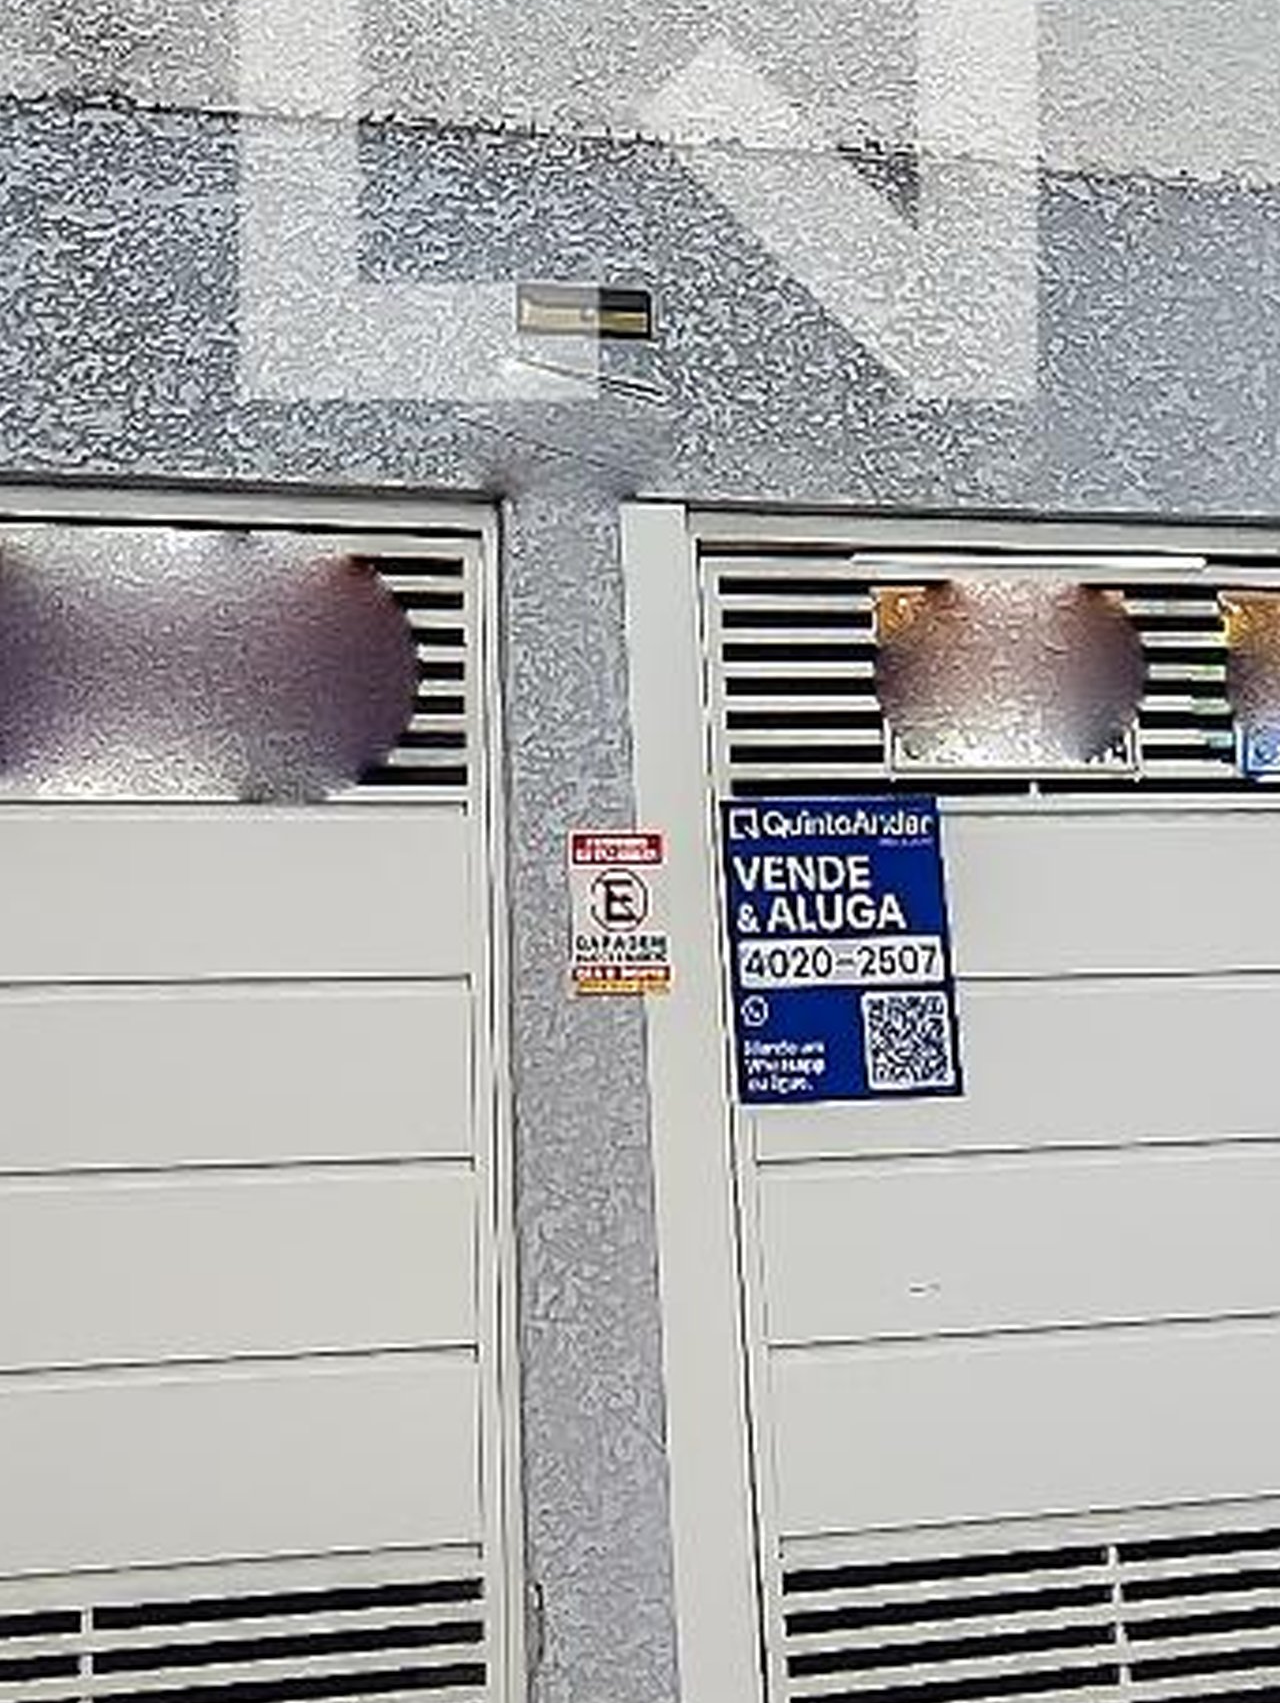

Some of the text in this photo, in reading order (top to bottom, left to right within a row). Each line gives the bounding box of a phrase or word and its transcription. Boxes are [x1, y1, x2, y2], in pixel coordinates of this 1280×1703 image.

[763, 809, 933, 839] QuintoAndar
[733, 855, 871, 891] VENDE
[737, 894, 907, 933] & ALUGA
[744, 945, 937, 980] 4020-2507
